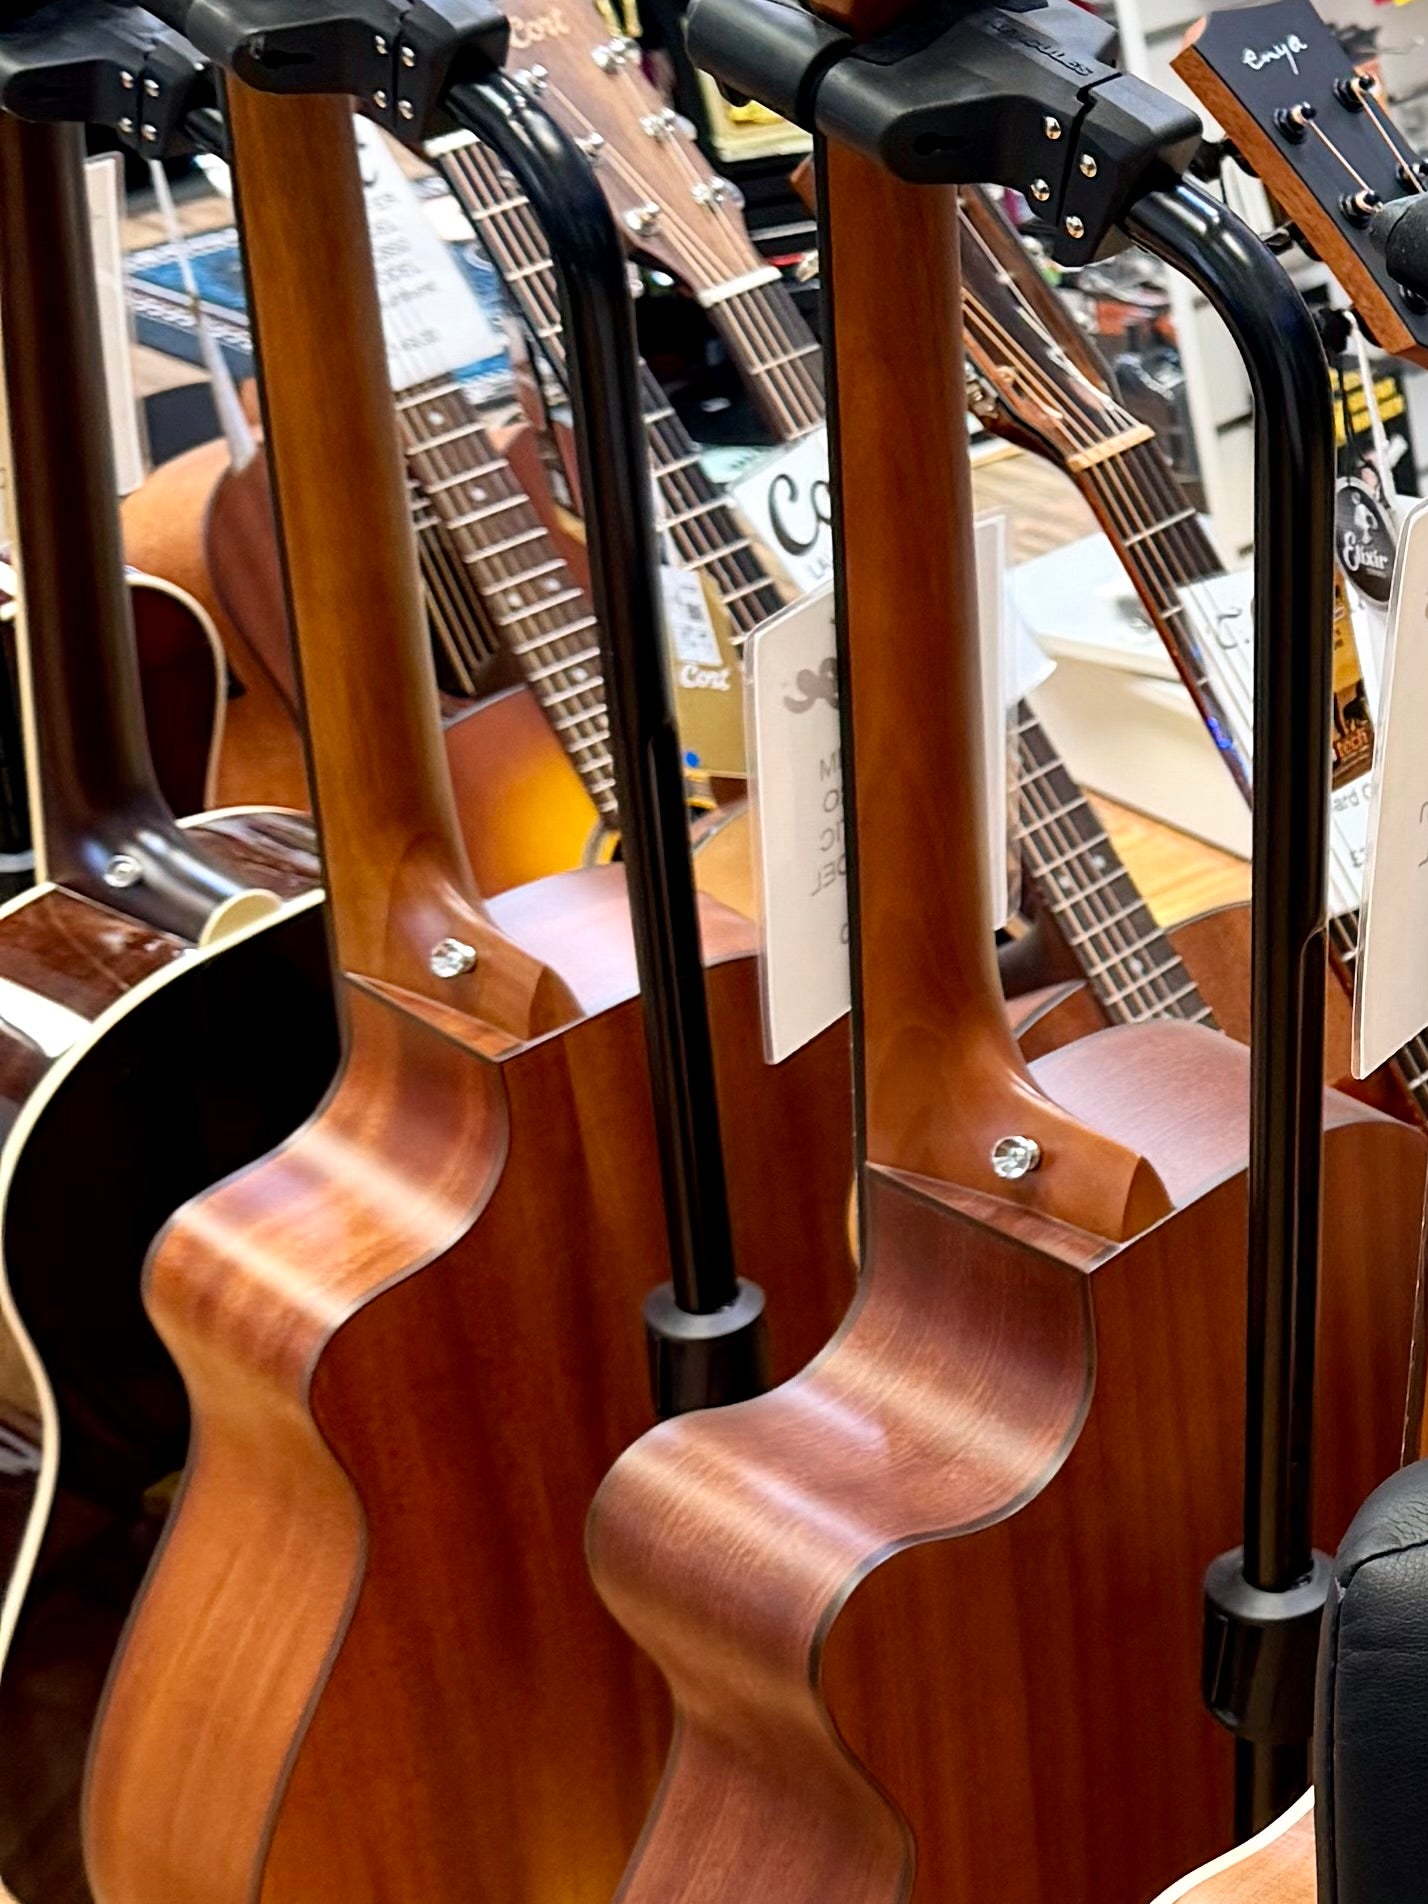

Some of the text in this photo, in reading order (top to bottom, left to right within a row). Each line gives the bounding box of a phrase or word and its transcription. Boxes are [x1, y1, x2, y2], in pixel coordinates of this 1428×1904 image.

[510, 8, 566, 49] Cort
[768, 473, 833, 557] Co
[1342, 534, 1390, 573] Elixir
[679, 664, 731, 692] Cort
